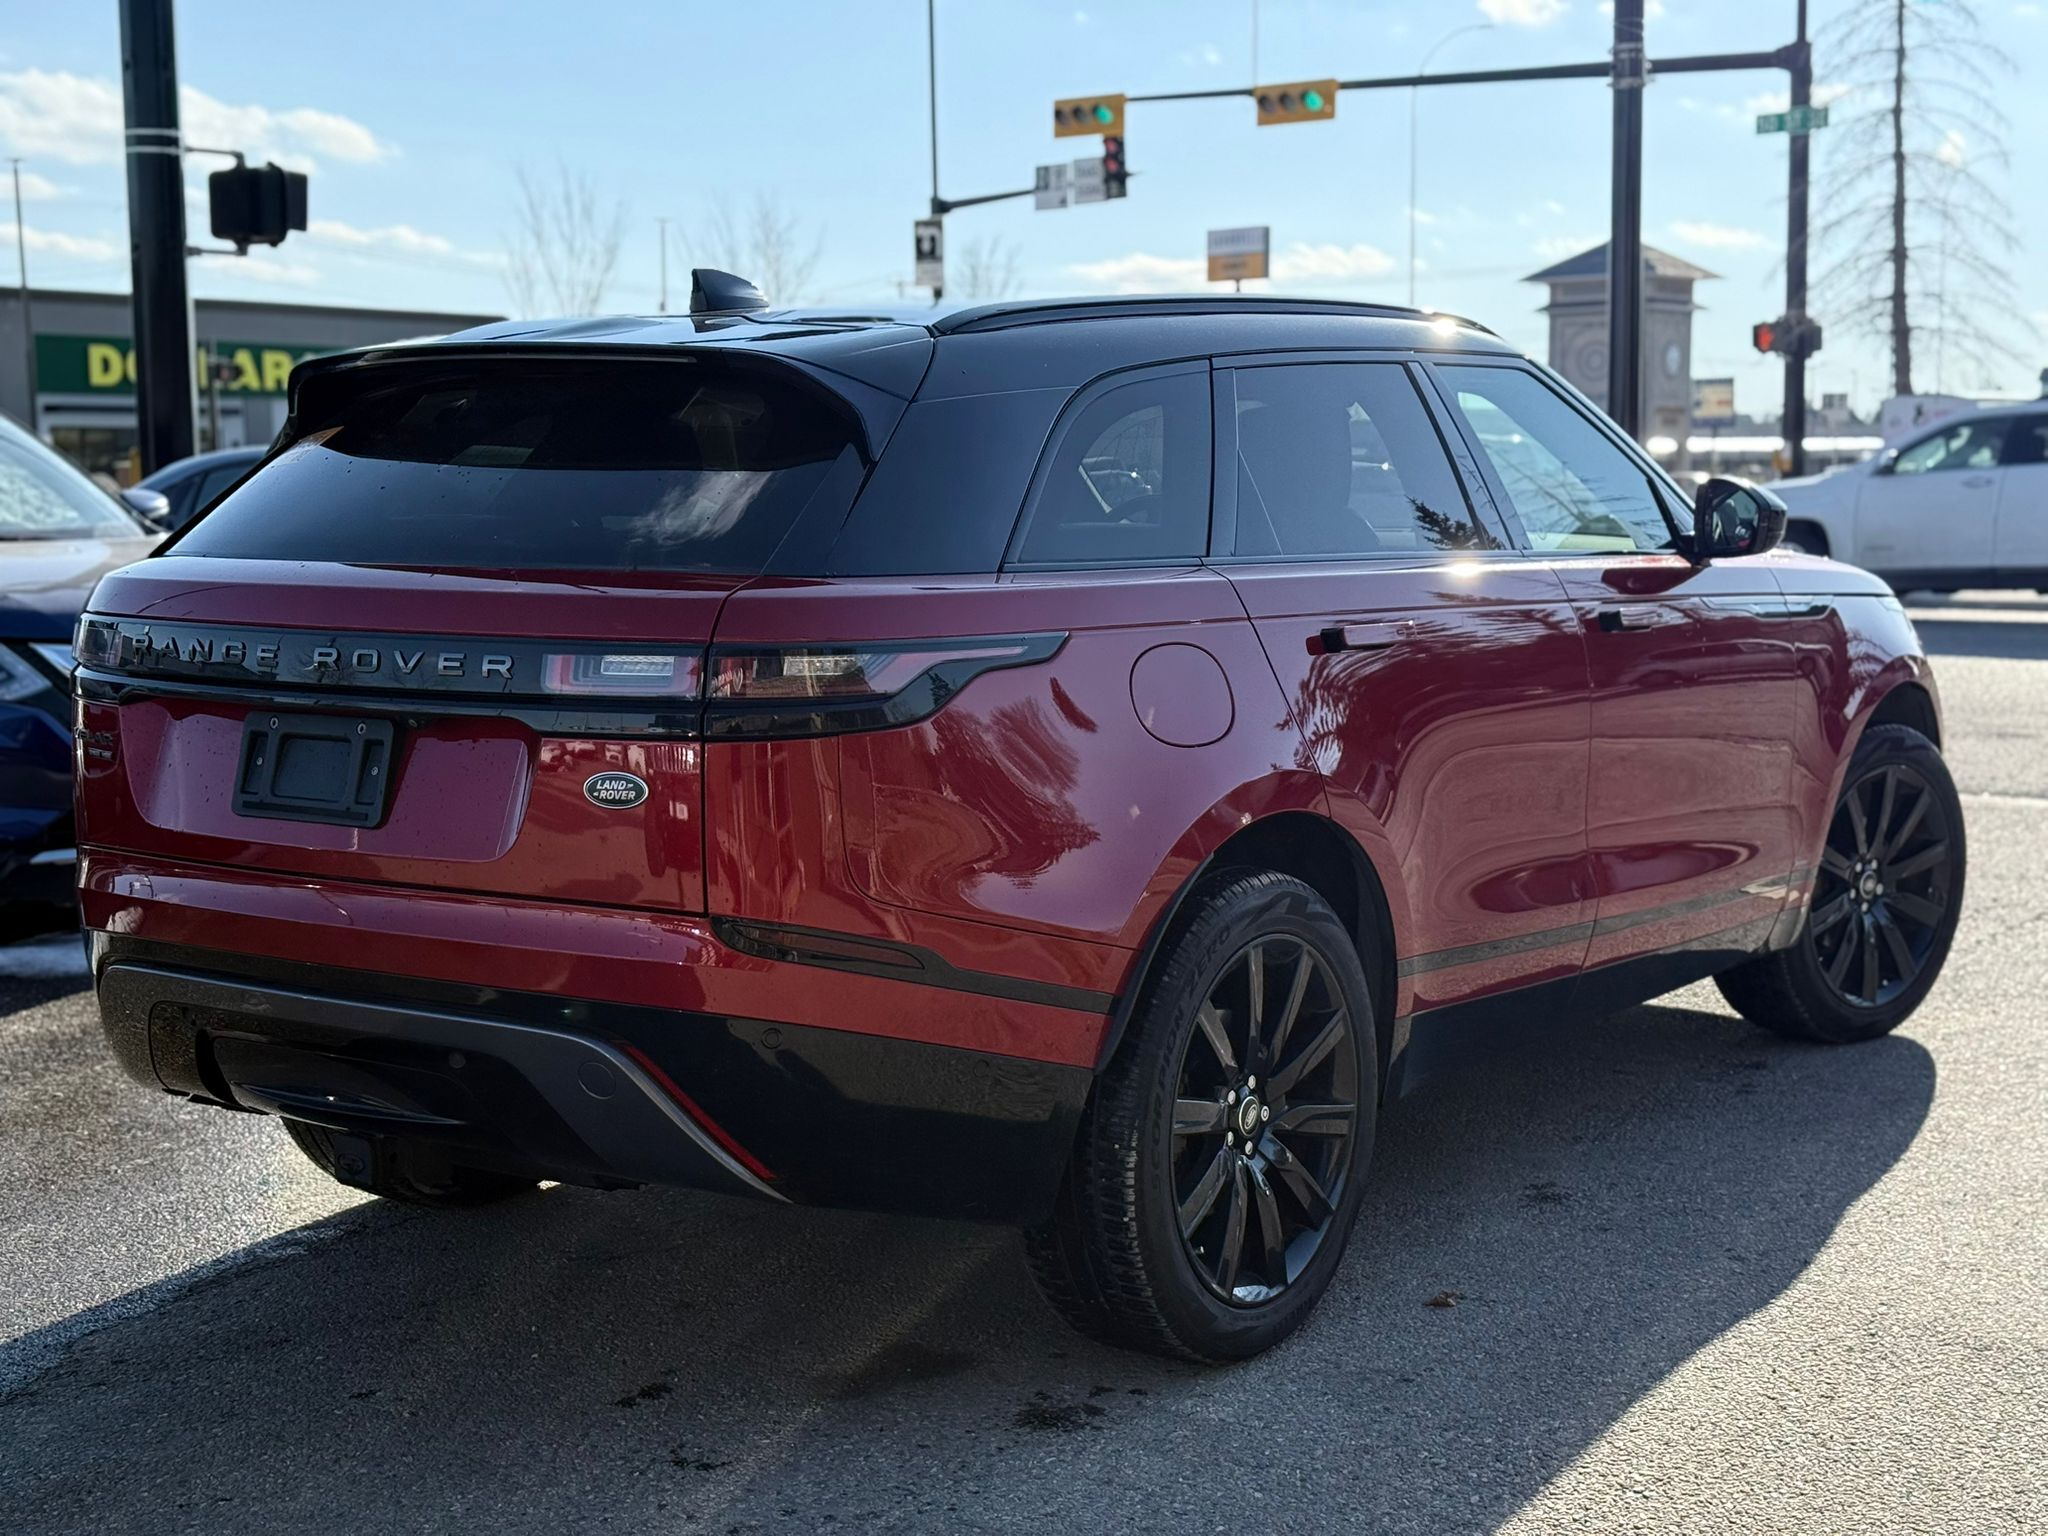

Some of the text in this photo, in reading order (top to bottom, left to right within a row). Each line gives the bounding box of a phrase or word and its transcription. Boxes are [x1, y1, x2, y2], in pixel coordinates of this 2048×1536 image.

[133, 633, 514, 679] RANGE ROVER
[596, 780, 627, 790] LAND
[599, 790, 636, 800] ROVER
